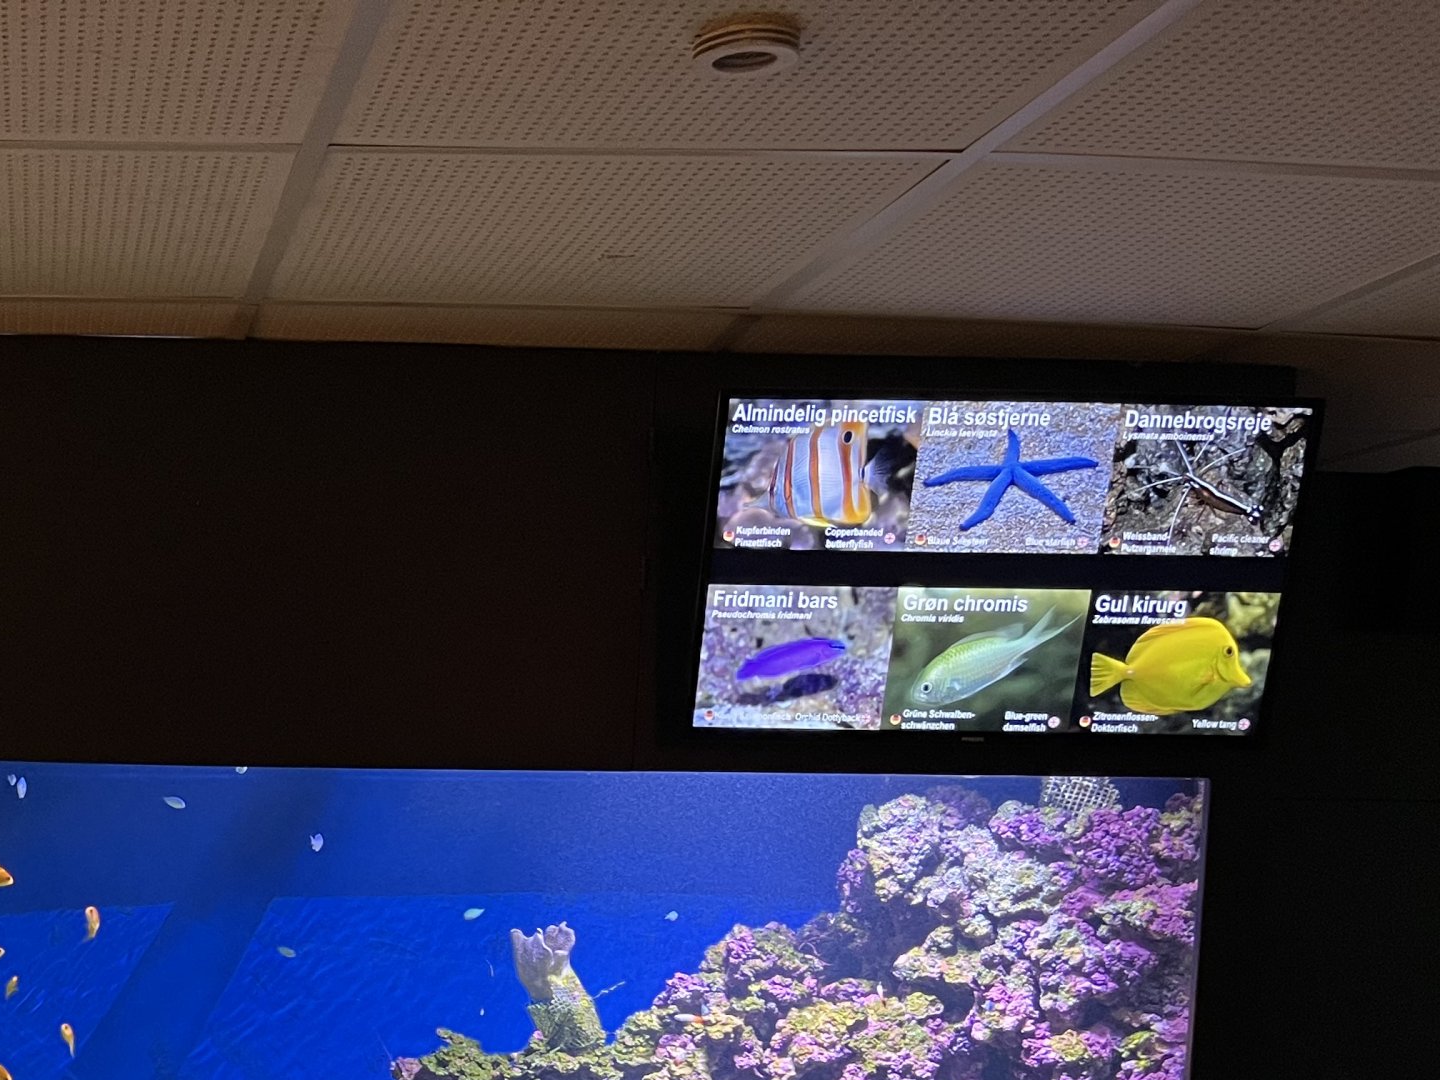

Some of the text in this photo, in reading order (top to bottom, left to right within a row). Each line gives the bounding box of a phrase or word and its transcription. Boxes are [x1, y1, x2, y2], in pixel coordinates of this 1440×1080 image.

[732, 404, 917, 427] Almindelig pincetfisk
[929, 407, 1050, 429] Blå søstjerne
[1125, 410, 1272, 434] Dannebrogsreje
[732, 425, 770, 434] Chelmon
[713, 590, 838, 608] Fridmani bars
[904, 594, 1028, 612] Grøn chromis
[1095, 595, 1188, 617] Gul kirurg
[1219, 720, 1236, 730] tang
